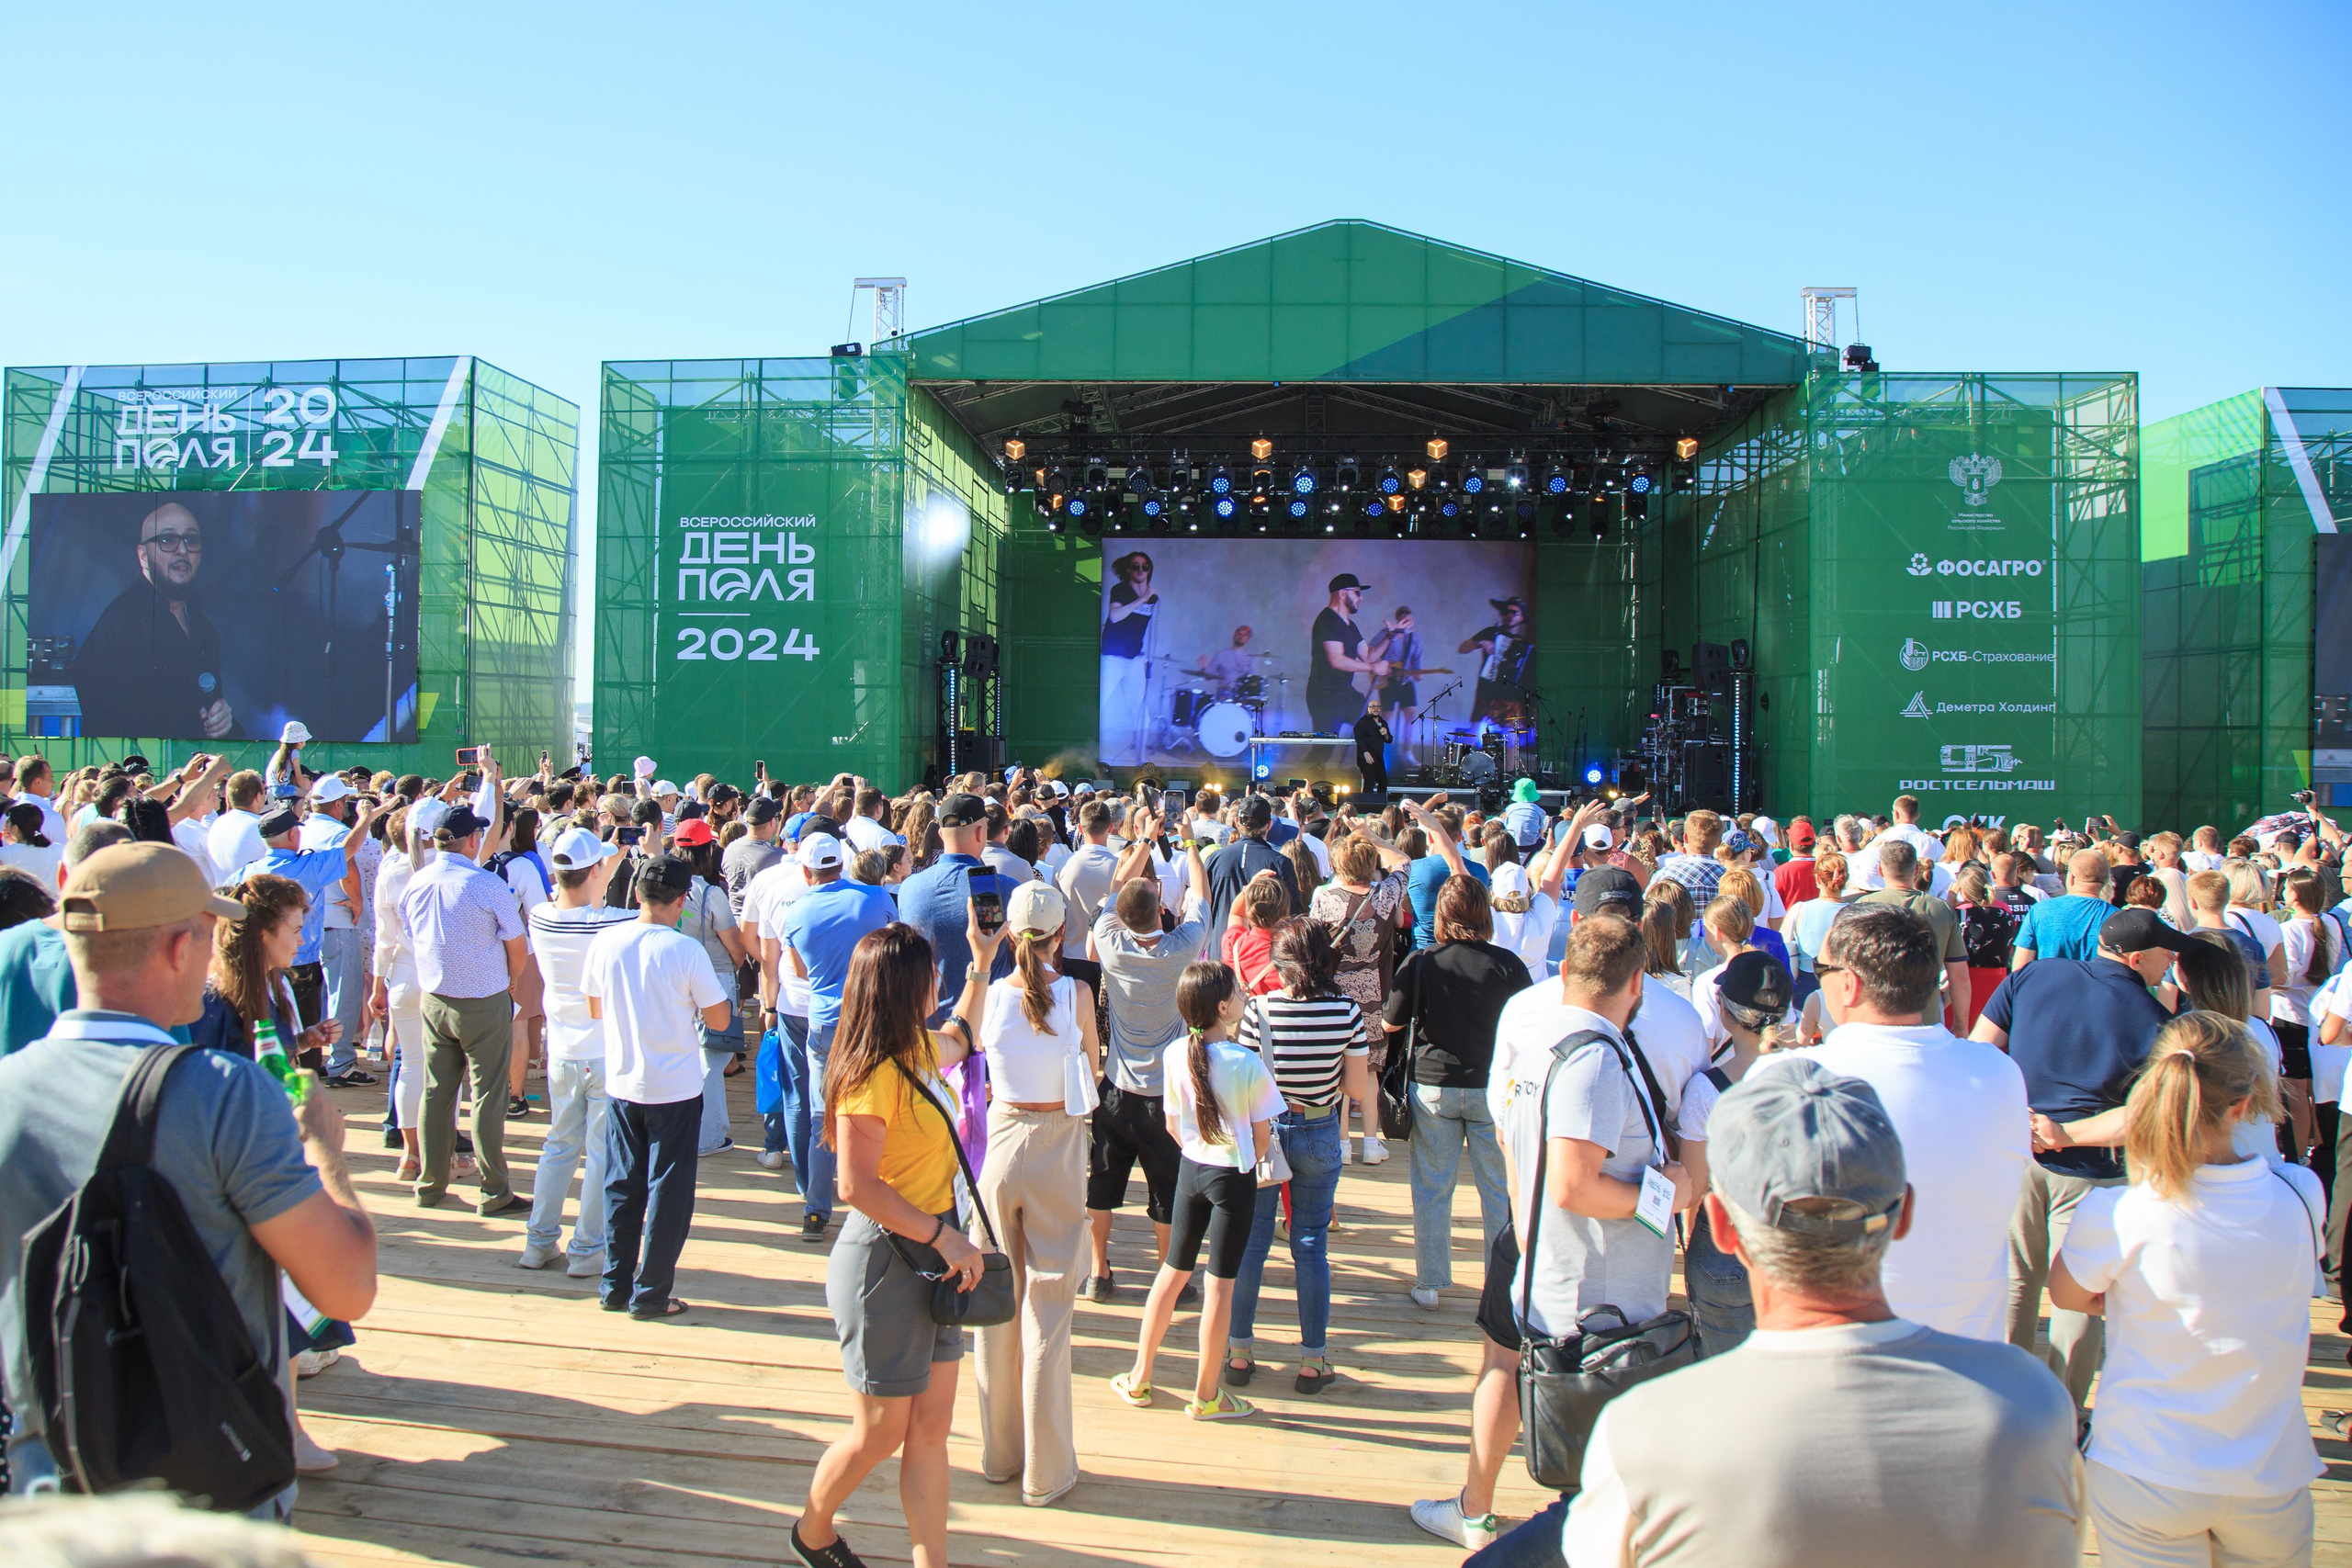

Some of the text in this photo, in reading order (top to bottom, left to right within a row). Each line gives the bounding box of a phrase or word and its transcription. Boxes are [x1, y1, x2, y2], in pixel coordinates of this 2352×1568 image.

[118, 387, 238, 401] ВСЕРОССИЙСКИЙ
[263, 387, 337, 423] 20
[117, 403, 237, 434] ДЕНЬ
[116, 437, 236, 469] ПОЛЯ
[262, 430, 339, 467] 24
[680, 513, 816, 527] ВСЕРОССИЙСКИЙ
[679, 532, 816, 564] ДЕНЬ
[1936, 559, 2042, 576] ФОСАГРО
[678, 568, 815, 602] ПОЛЯ
[1956, 601, 2022, 618] РСХБ
[677, 627, 820, 660] 2024
[1932, 650, 2055, 664] РСХБ-Страхование
[1936, 701, 2055, 714] Деметра Холдинг
[1899, 780, 2055, 790] РОСТСЕЛЬМАШ
